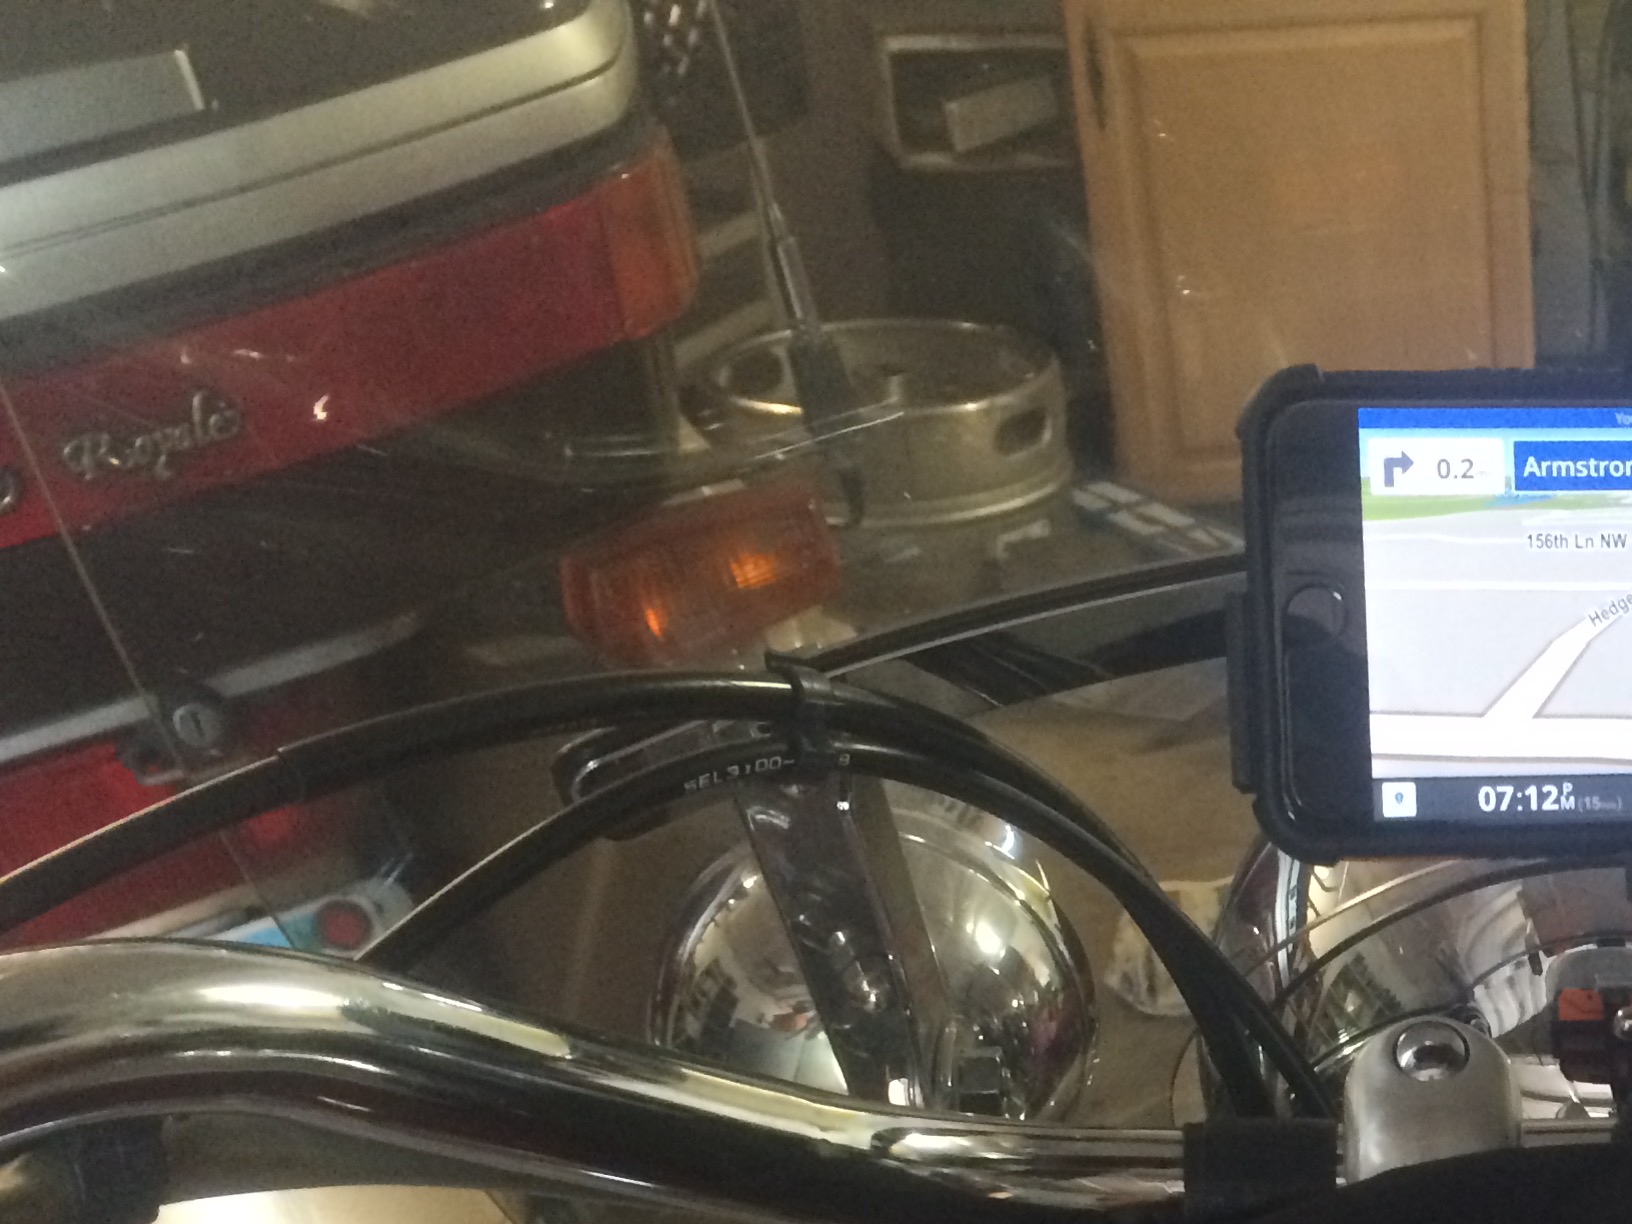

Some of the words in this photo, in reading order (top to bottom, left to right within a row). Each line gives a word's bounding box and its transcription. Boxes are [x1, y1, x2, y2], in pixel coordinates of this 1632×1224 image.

[1437, 457, 1475, 480] 0.2
[1526, 533, 1569, 549] 156th
[1574, 533, 1594, 549] Ln
[1600, 533, 1628, 549] NW
[1477, 784, 1560, 813] 07:12
